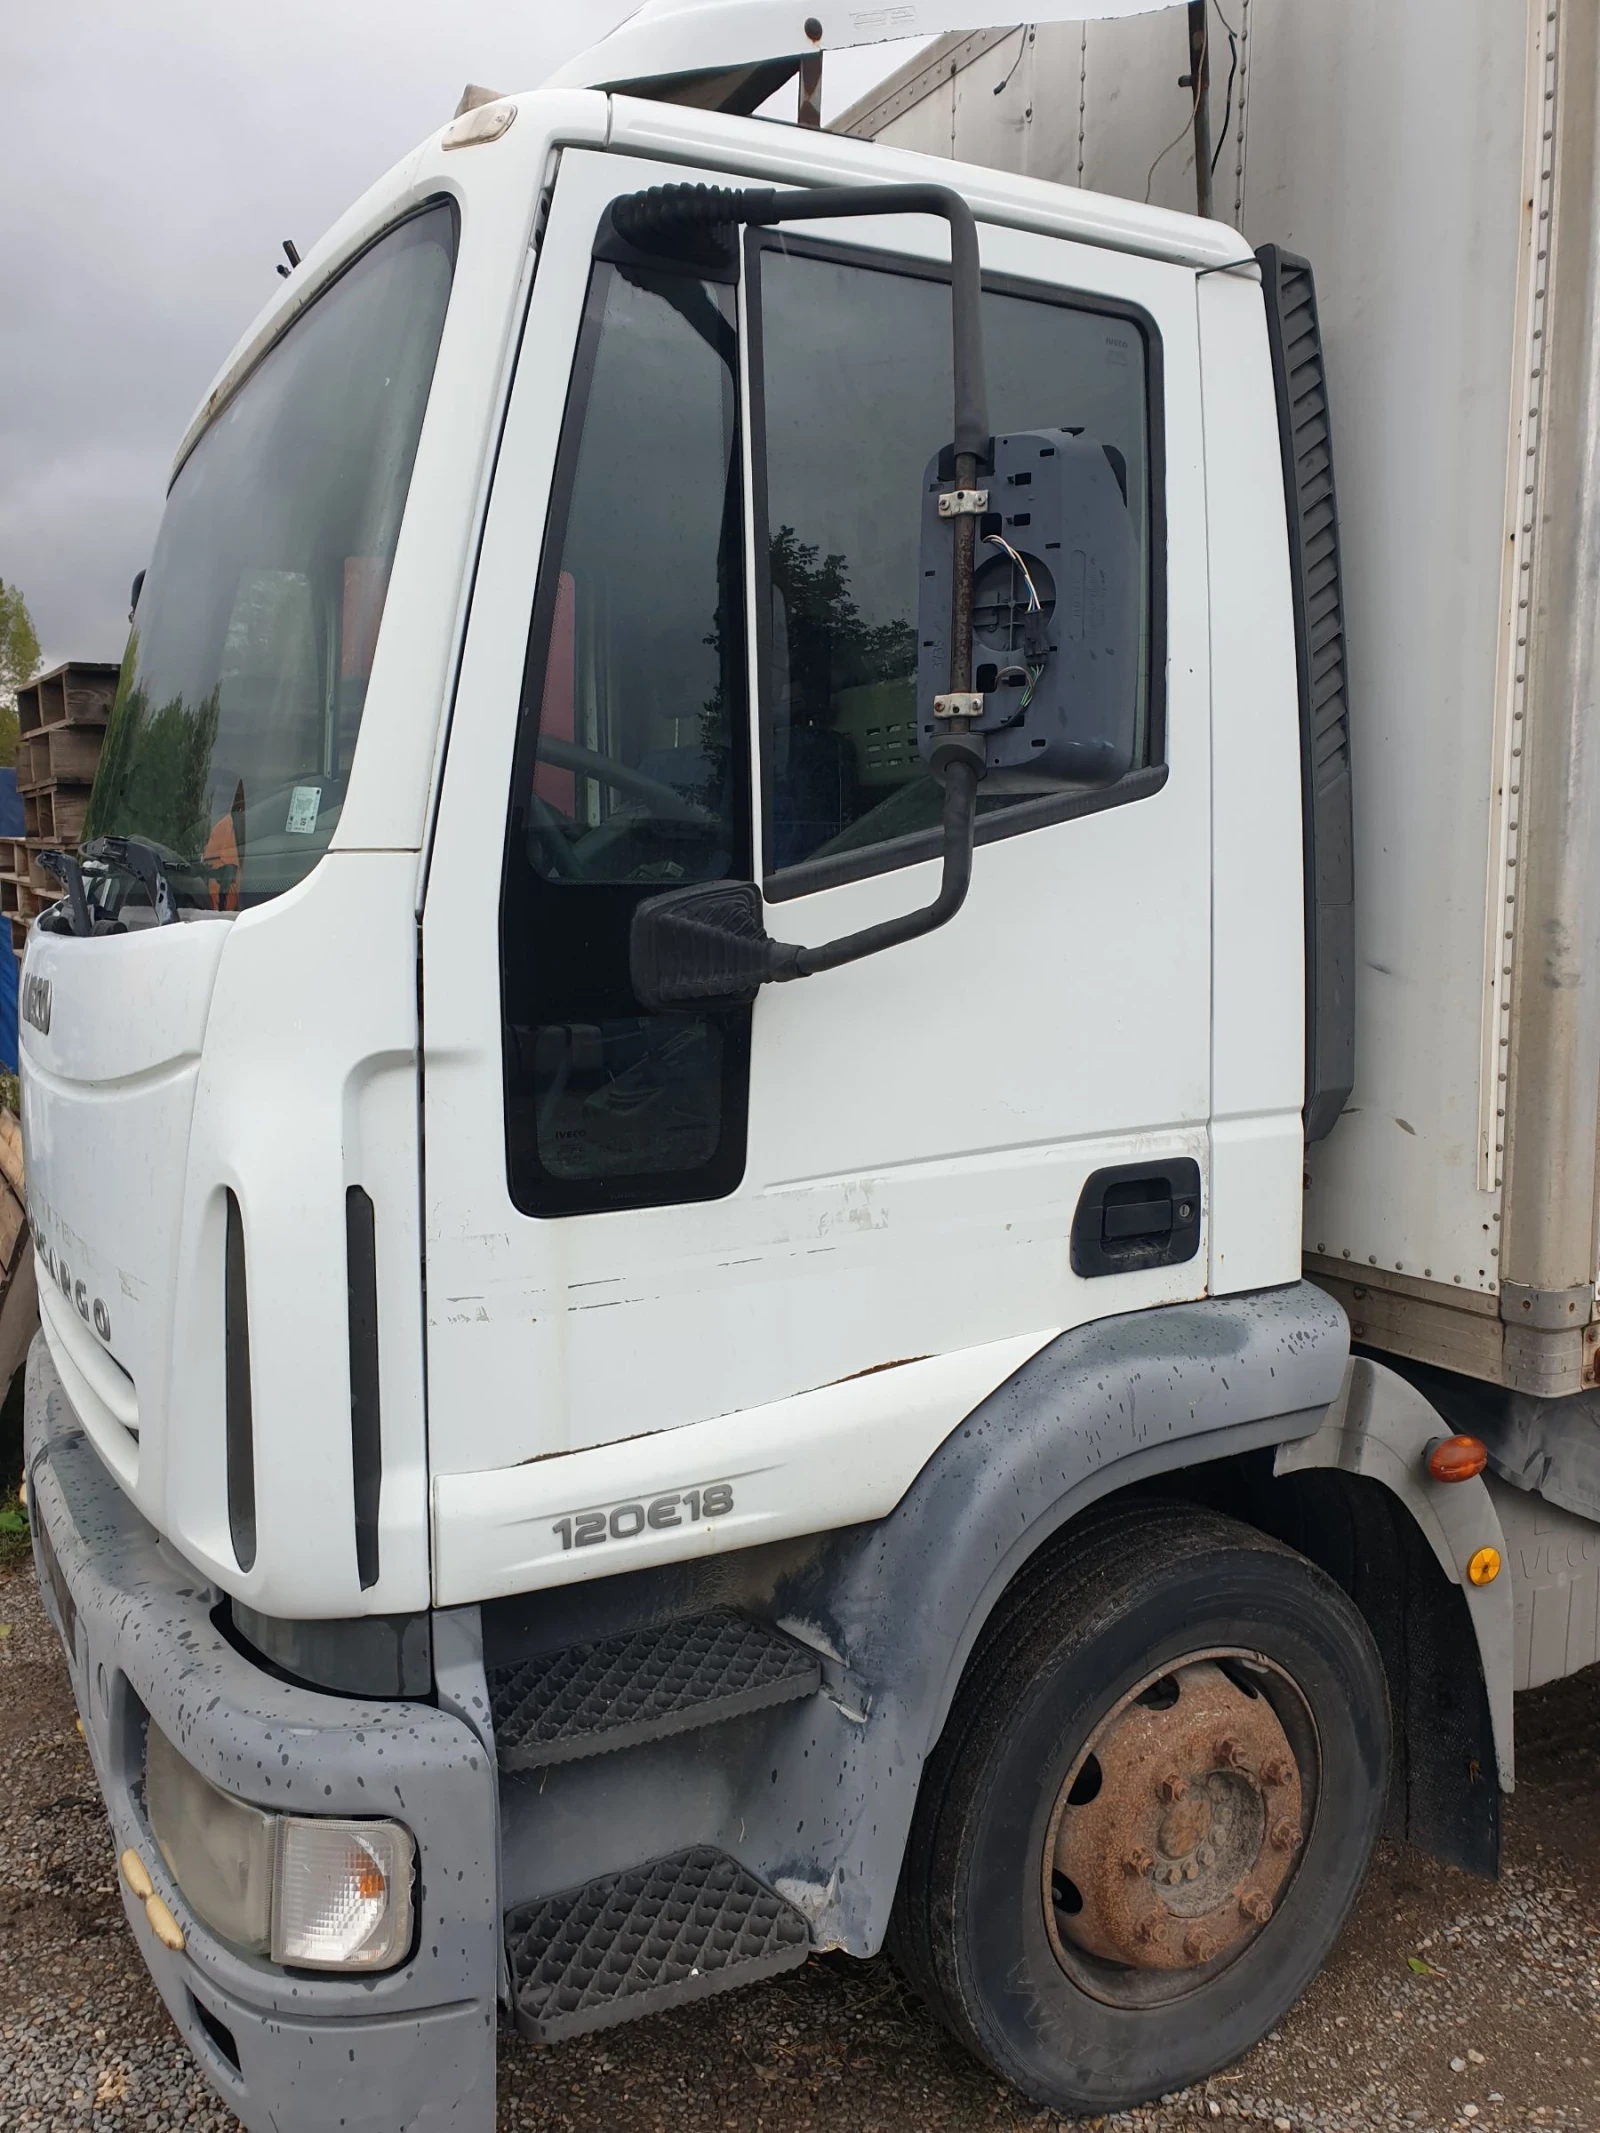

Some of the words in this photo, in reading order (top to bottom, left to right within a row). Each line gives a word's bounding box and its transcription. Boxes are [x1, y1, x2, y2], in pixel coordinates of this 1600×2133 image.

[1105, 336, 1129, 349] IVECO
[554, 1129, 587, 1140] IVECO
[552, 1483, 735, 1551] 120E18
